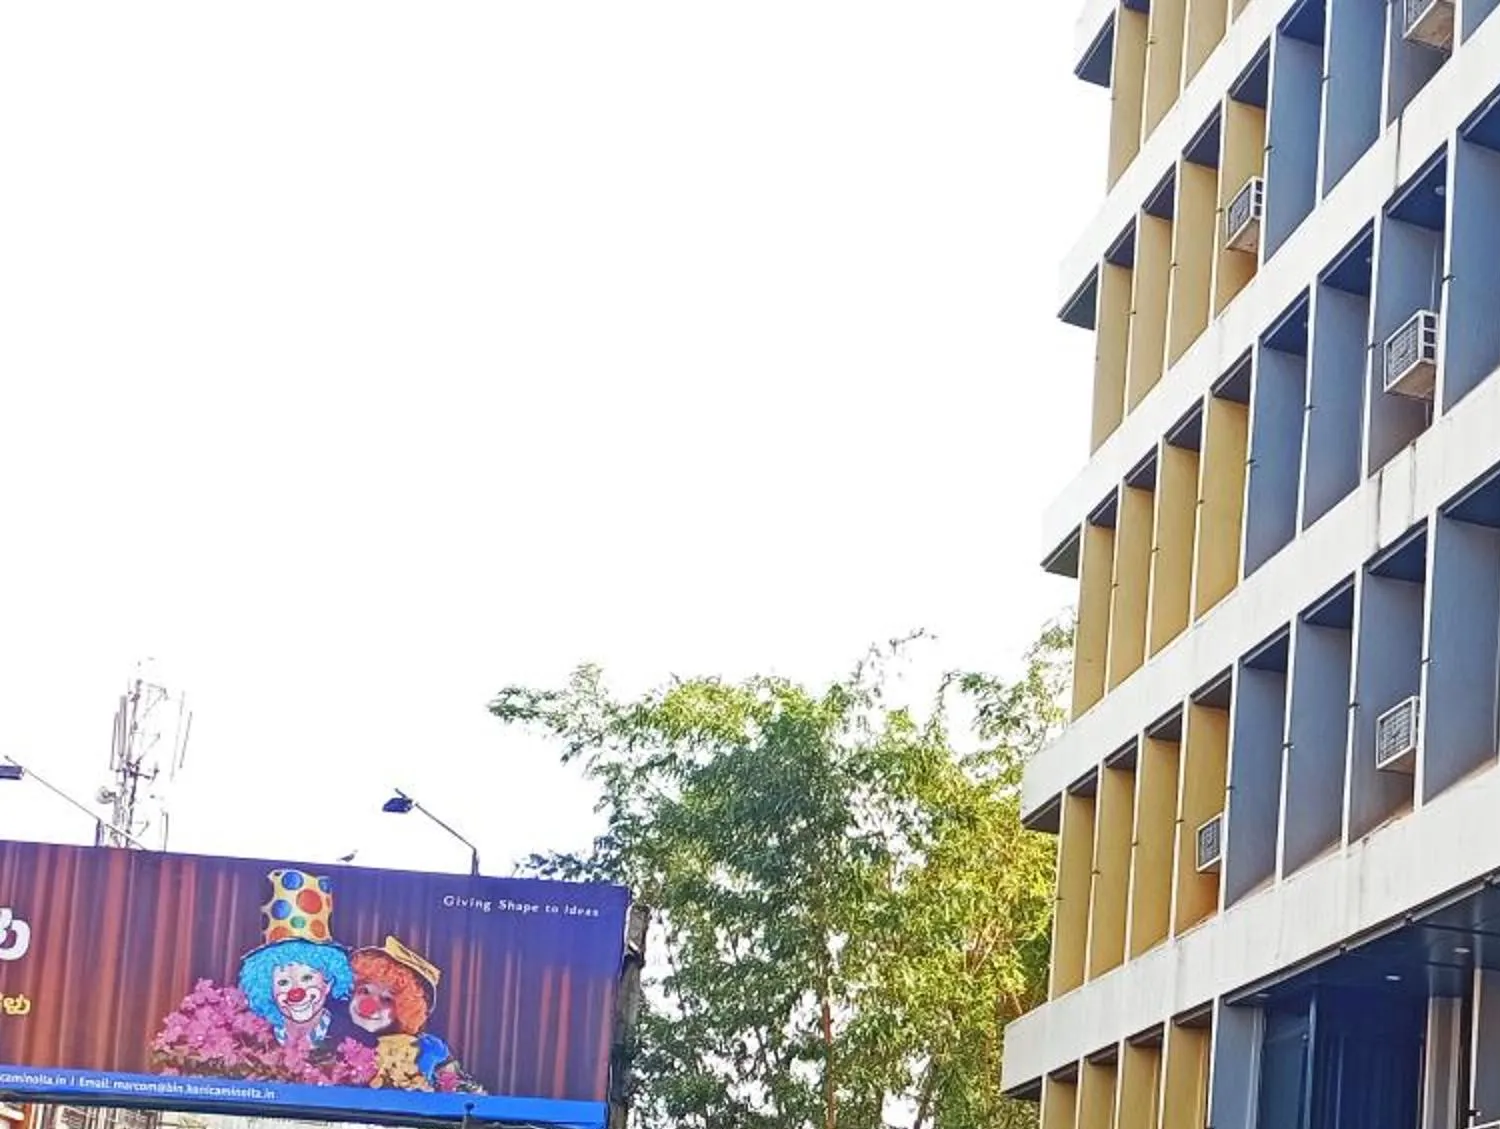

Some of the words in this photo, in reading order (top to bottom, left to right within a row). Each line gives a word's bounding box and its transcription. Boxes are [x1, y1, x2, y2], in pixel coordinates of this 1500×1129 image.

[443, 895, 492, 912] Giving
[498, 900, 540, 914] Shape
[545, 903, 560, 914] to
[564, 904, 600, 917] Ideas
